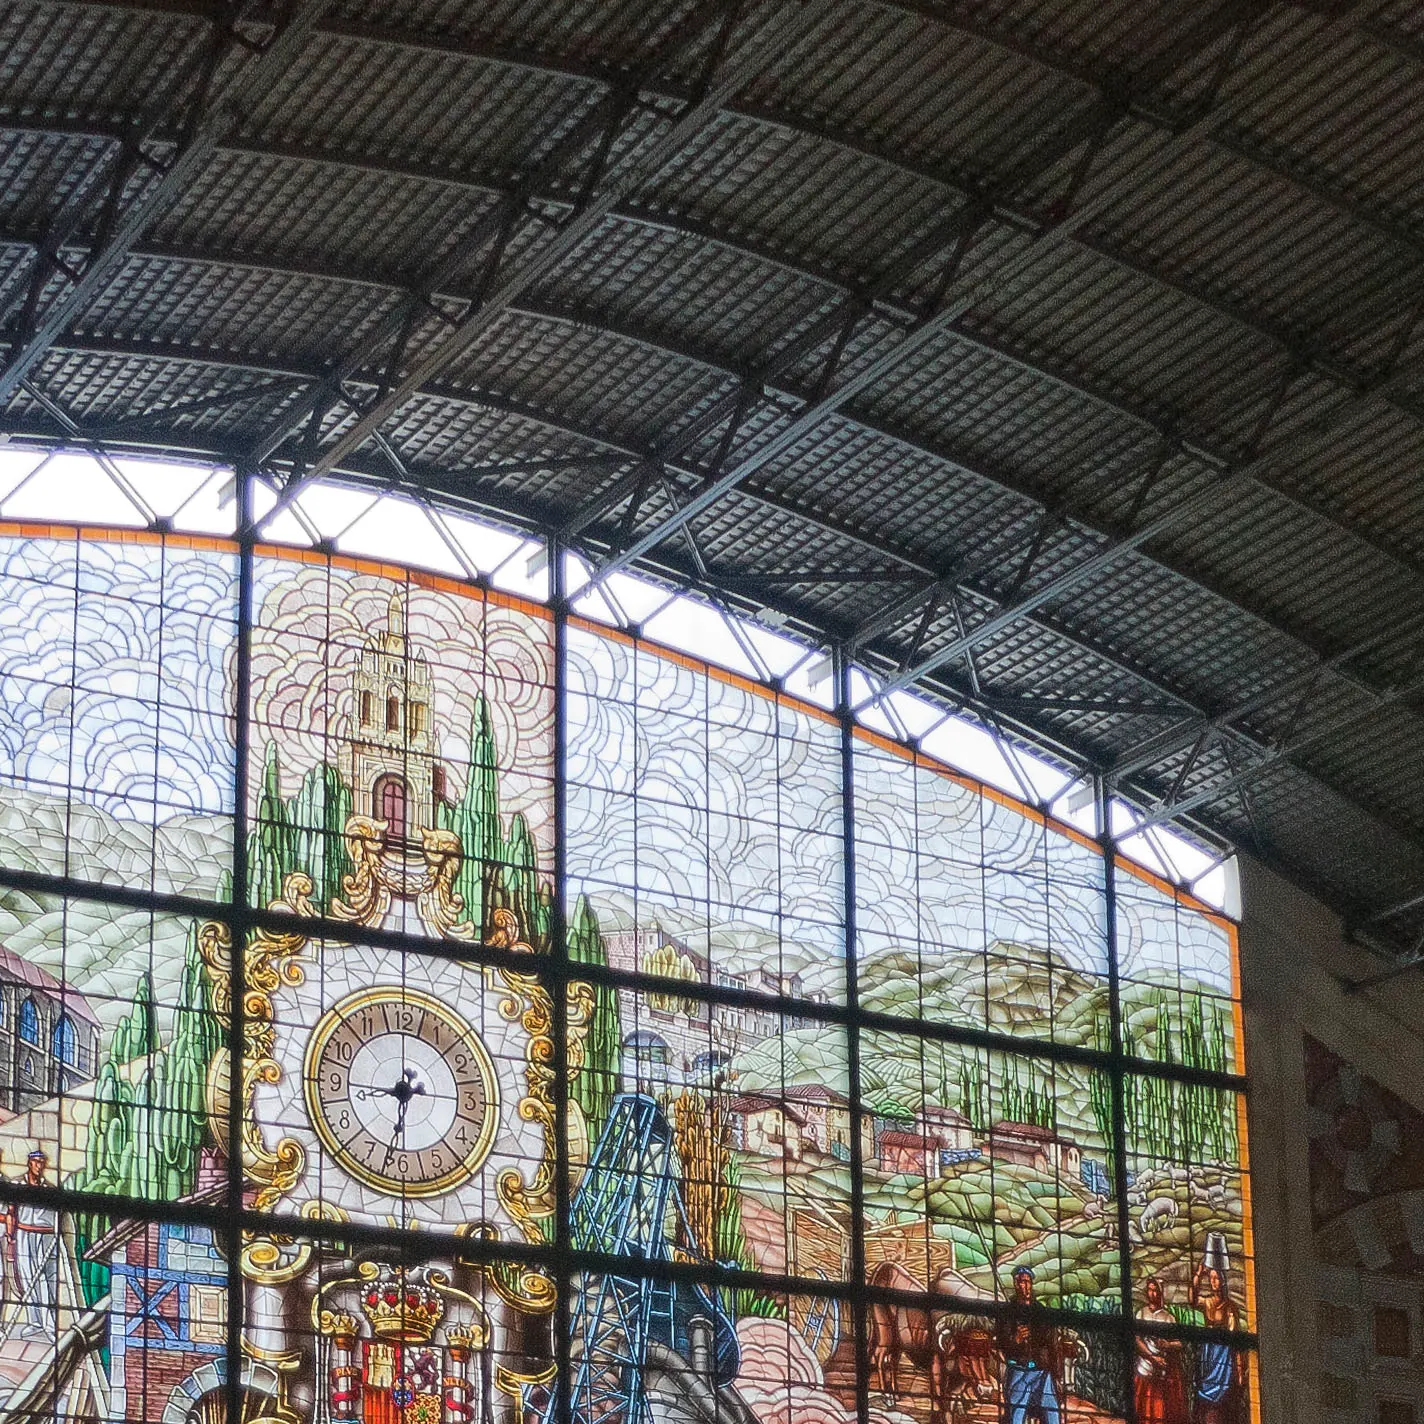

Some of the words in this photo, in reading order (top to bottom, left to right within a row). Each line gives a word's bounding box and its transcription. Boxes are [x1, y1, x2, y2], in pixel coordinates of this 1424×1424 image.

[362, 1016, 373, 1037] 11
[394, 1010, 414, 1031] 12
[432, 1025, 440, 1046] 1
[335, 1042, 353, 1062] 10
[455, 1054, 468, 1074] 2
[330, 1073, 342, 1092] 9
[464, 1091, 476, 1111] 3
[339, 1109, 350, 1130] 8
[455, 1125, 468, 1145] 4
[365, 1141, 376, 1160] 7
[431, 1149, 443, 1169] 5
[397, 1153, 409, 1174] 6
